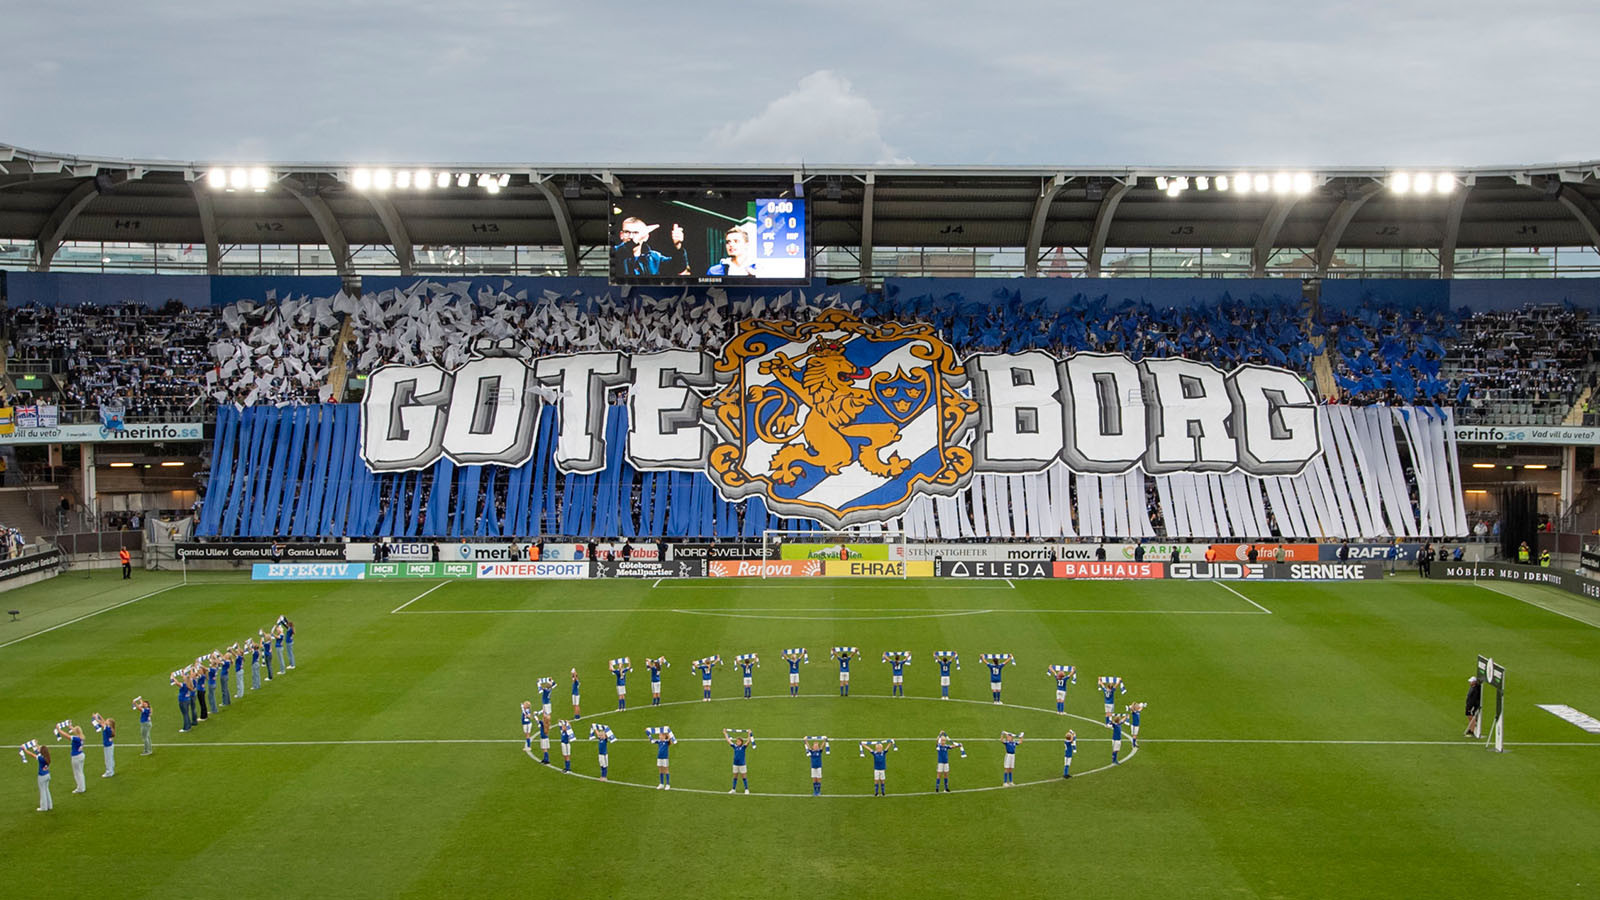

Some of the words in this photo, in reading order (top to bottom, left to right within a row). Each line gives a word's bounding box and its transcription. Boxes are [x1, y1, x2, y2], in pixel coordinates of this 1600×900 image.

[768, 202, 793, 213] 0:00
[115, 220, 141, 231] H1
[256, 222, 285, 232] H2
[765, 218, 772, 228] 0
[789, 217, 796, 228] 0
[471, 223, 499, 233] H3
[940, 226, 964, 235] J4
[1170, 226, 1194, 235] J3
[1376, 227, 1399, 236] J2
[1516, 226, 1537, 234] J1
[114, 424, 199, 439] merinfo.se
[1532, 430, 1548, 438] Vad
[1550, 430, 1560, 438] vill
[1563, 431, 1572, 439] du
[177, 548, 204, 556] Gamla
[205, 548, 229, 556] Ullevi
[233, 548, 260, 556] Gamla
[260, 548, 284, 556] Ulli
[288, 548, 314, 556] Gamla
[315, 548, 339, 556] Ullevi
[1061, 547, 1091, 559] law.
[374, 565, 394, 573] MCR
[411, 565, 431, 573] MCR
[448, 565, 467, 573] MCR
[495, 564, 583, 576] INTERSPORT
[619, 562, 662, 570] Göteborgs
[737, 561, 792, 576] Renova
[976, 563, 1046, 576] ELEDA
[1066, 564, 1151, 576] BAUHAUS
[1170, 563, 1264, 579] GUIDE
[616, 569, 673, 577] Metallpartier
[1290, 564, 1364, 579] SERNEKE
[1447, 566, 1495, 577] MÖBLER
[1500, 569, 1520, 579] MED
